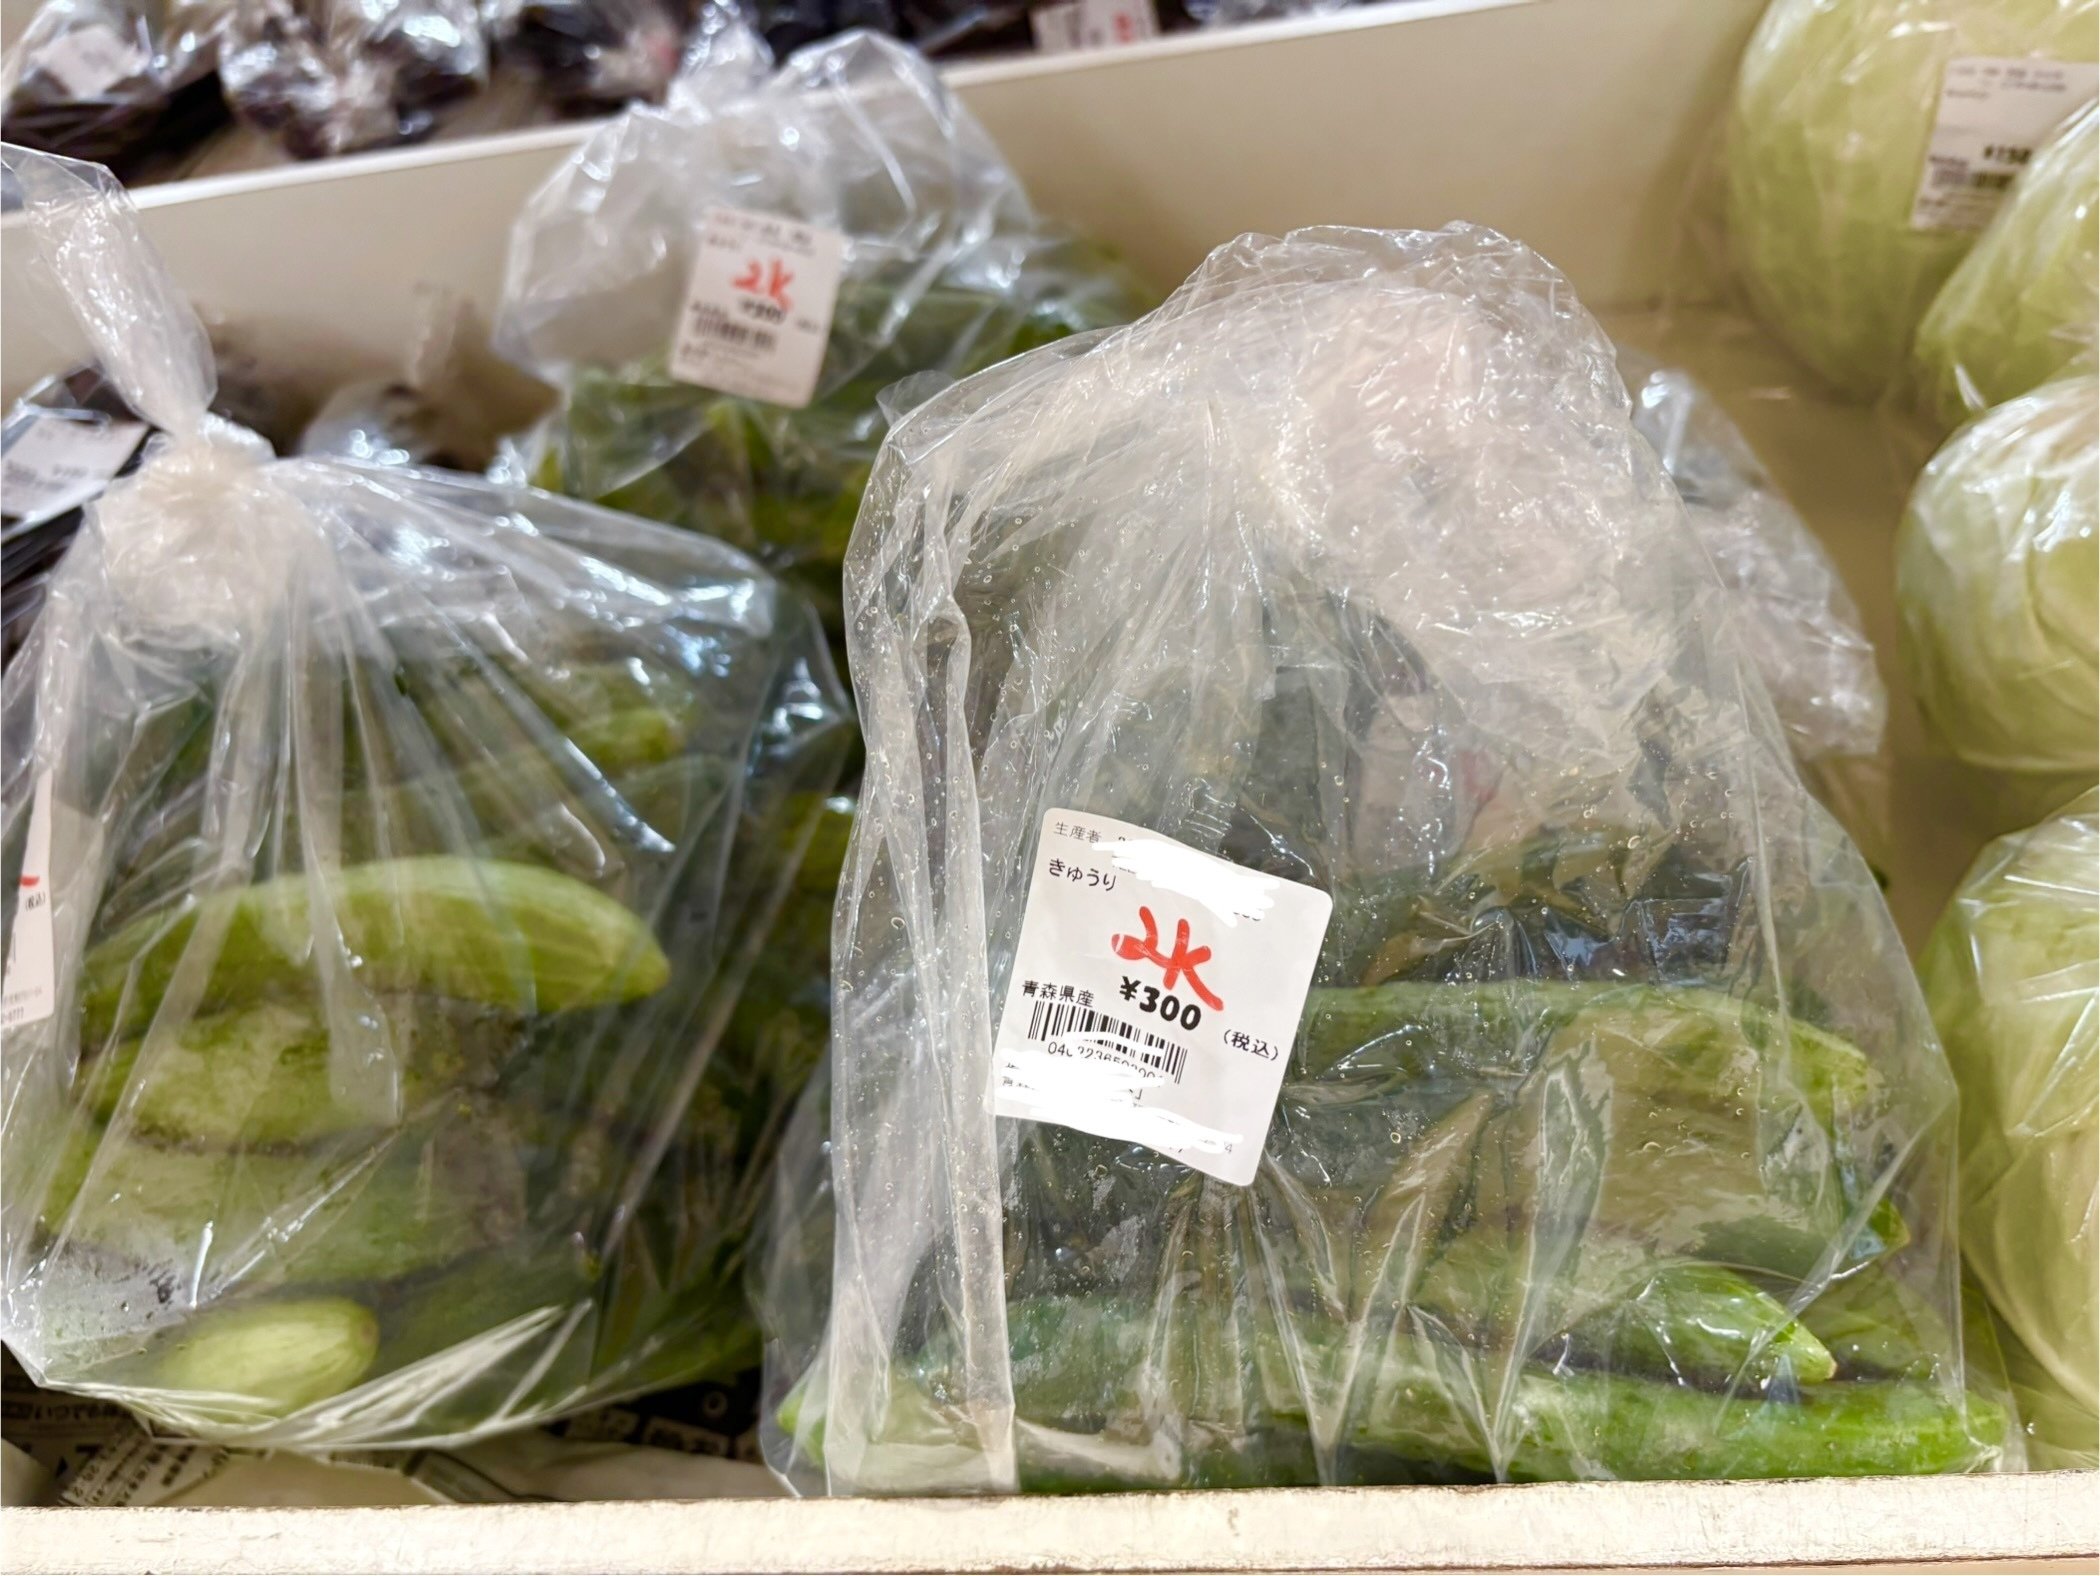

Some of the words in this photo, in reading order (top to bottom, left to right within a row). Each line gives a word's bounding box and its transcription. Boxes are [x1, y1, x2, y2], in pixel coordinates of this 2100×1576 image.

[1053, 820, 1101, 843] 生産者
[1048, 858, 1117, 891] きゅうり
[1021, 980, 1095, 1008] 青森県産
[1119, 976, 1202, 1031] ¥300
[1223, 1029, 1280, 1061] (税込)
